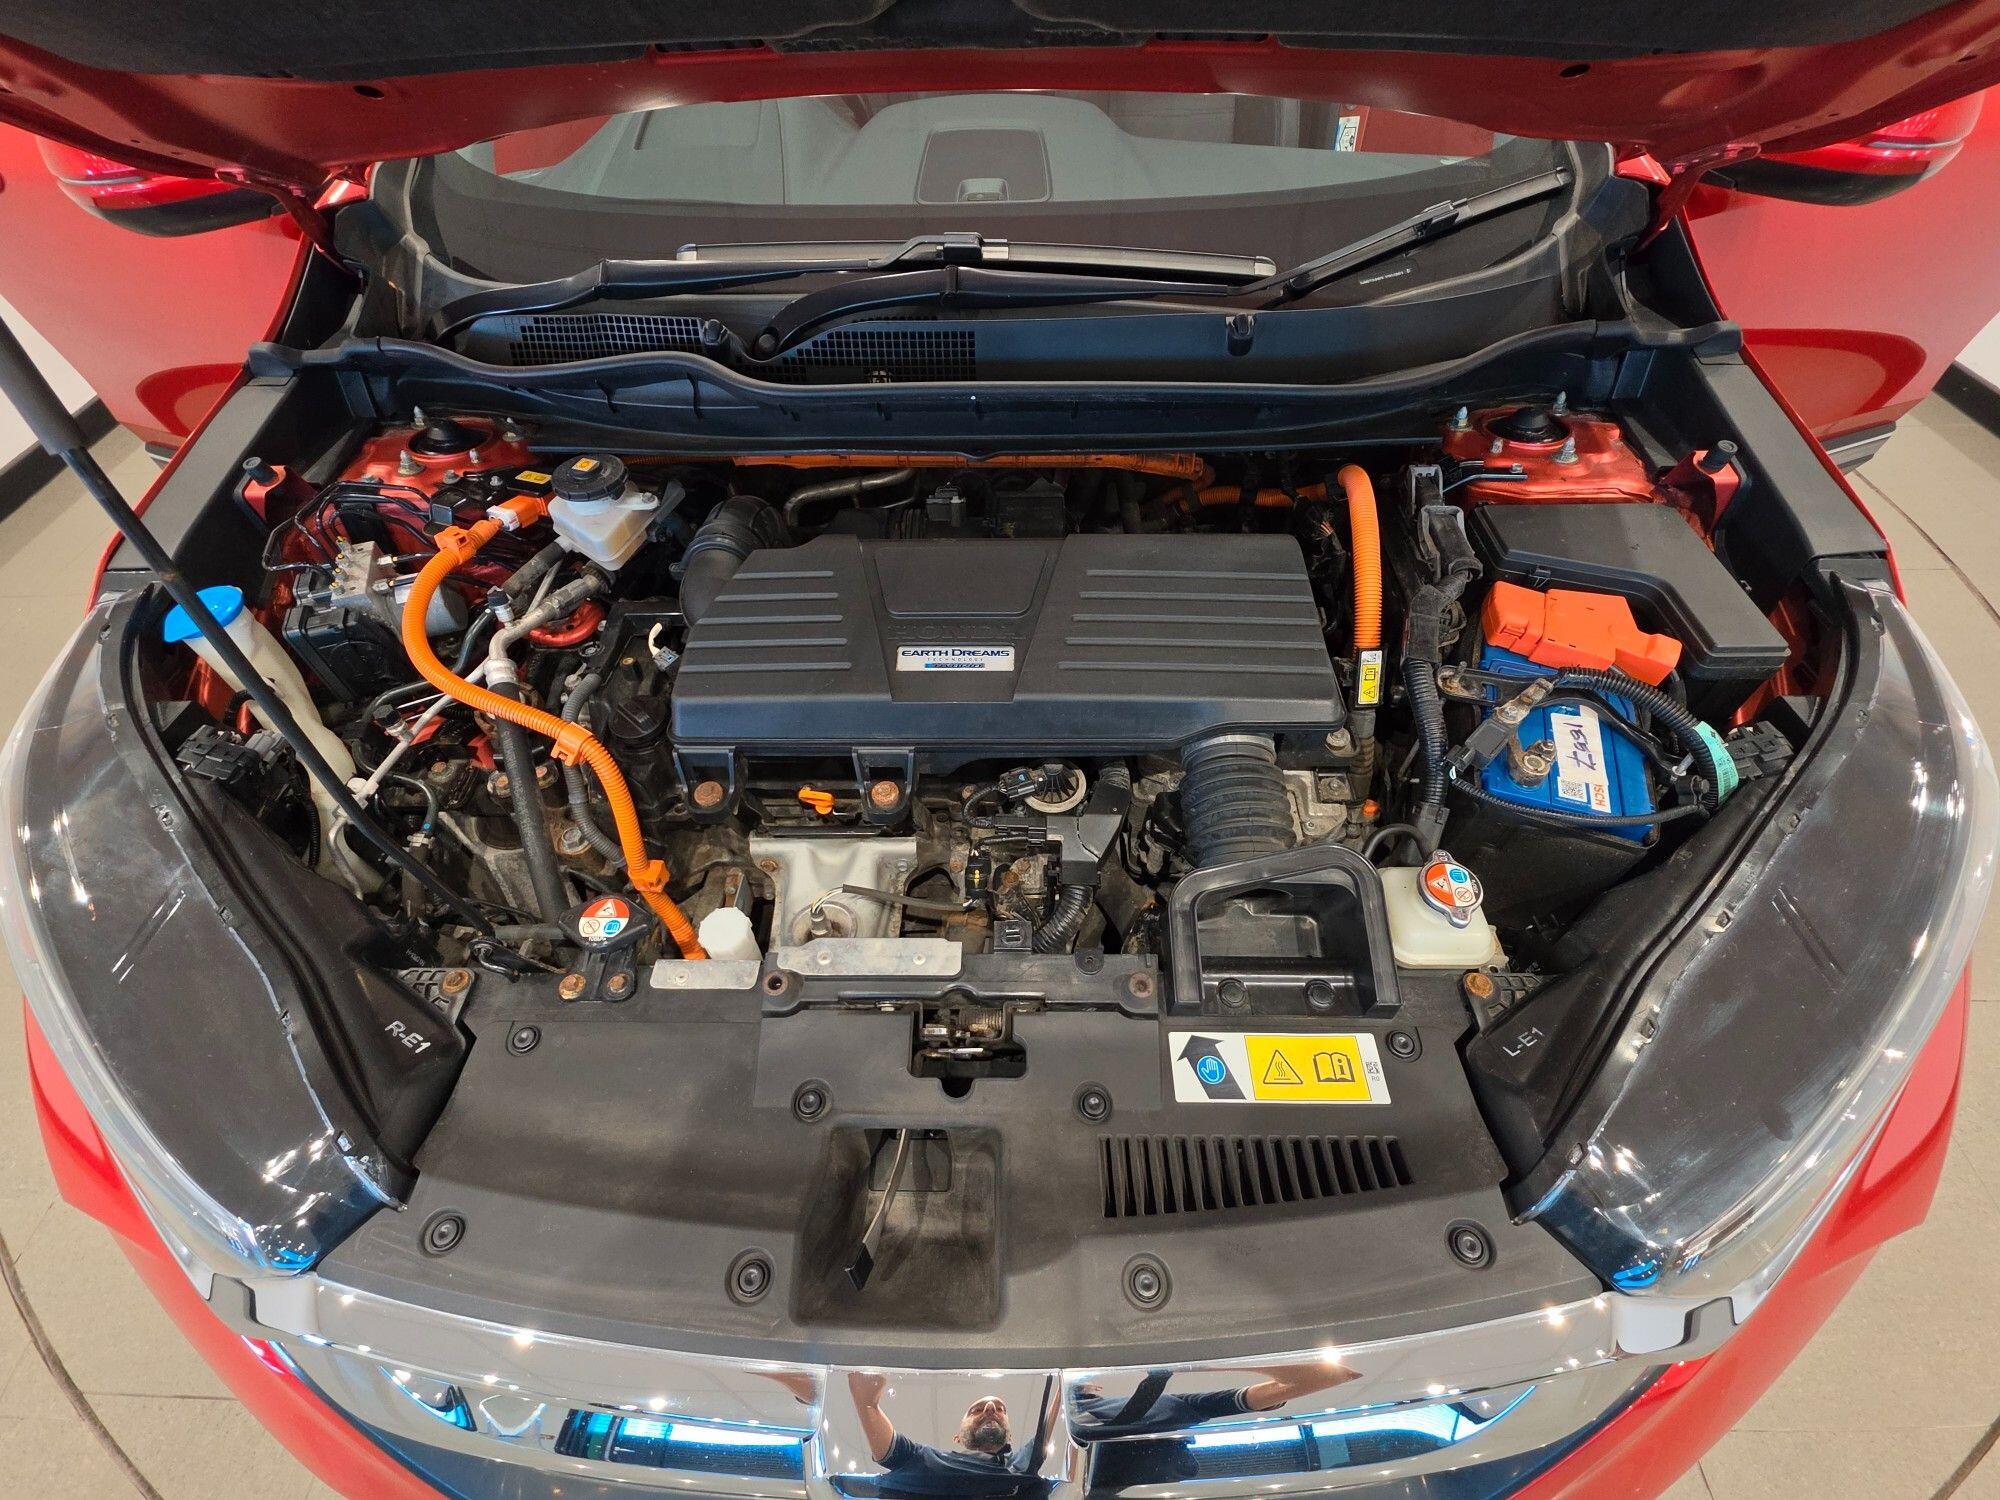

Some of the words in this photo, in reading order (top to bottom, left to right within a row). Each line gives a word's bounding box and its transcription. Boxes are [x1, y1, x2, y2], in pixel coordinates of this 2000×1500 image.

[952, 648, 1010, 657] DREAMS
[1594, 784, 1606, 807] SCH
[384, 1020, 432, 1054] R-E1
[1502, 1026, 1545, 1057] L-E1
